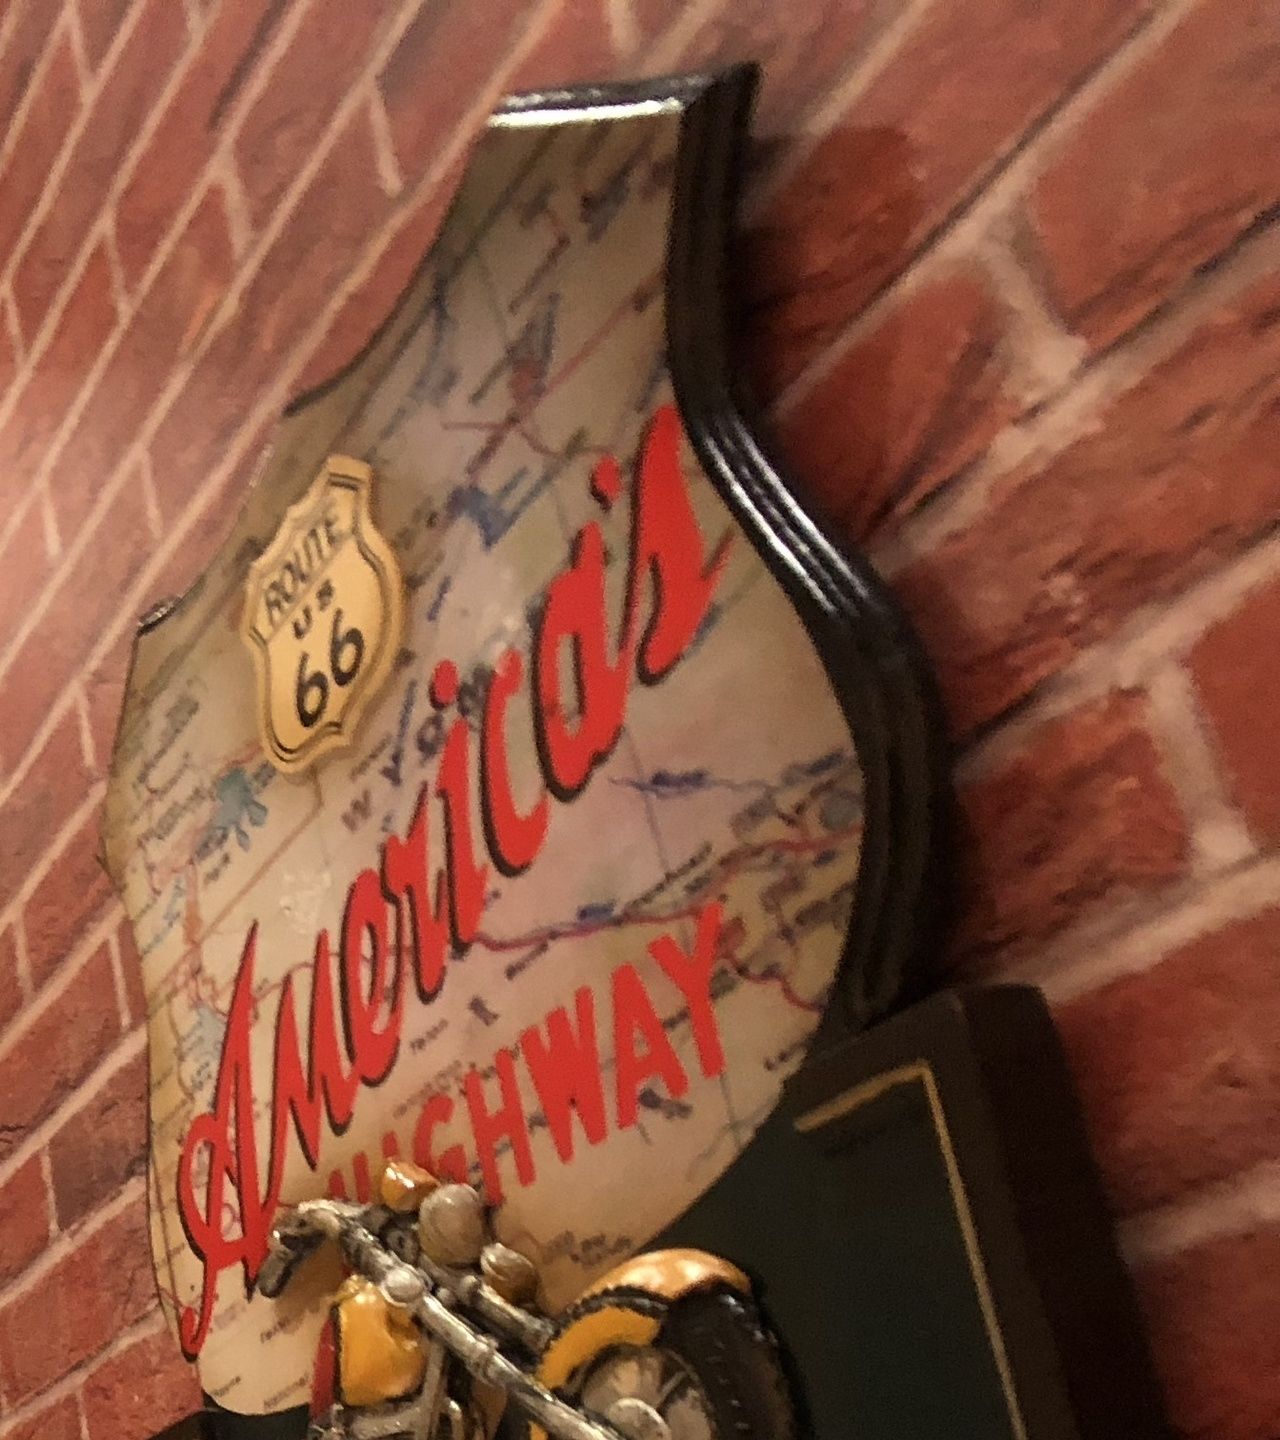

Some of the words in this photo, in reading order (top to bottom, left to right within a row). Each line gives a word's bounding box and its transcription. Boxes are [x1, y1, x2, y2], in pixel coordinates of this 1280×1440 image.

[265, 505, 339, 628] ROUTE
[293, 579, 334, 639] US
[296, 608, 365, 728] 66
